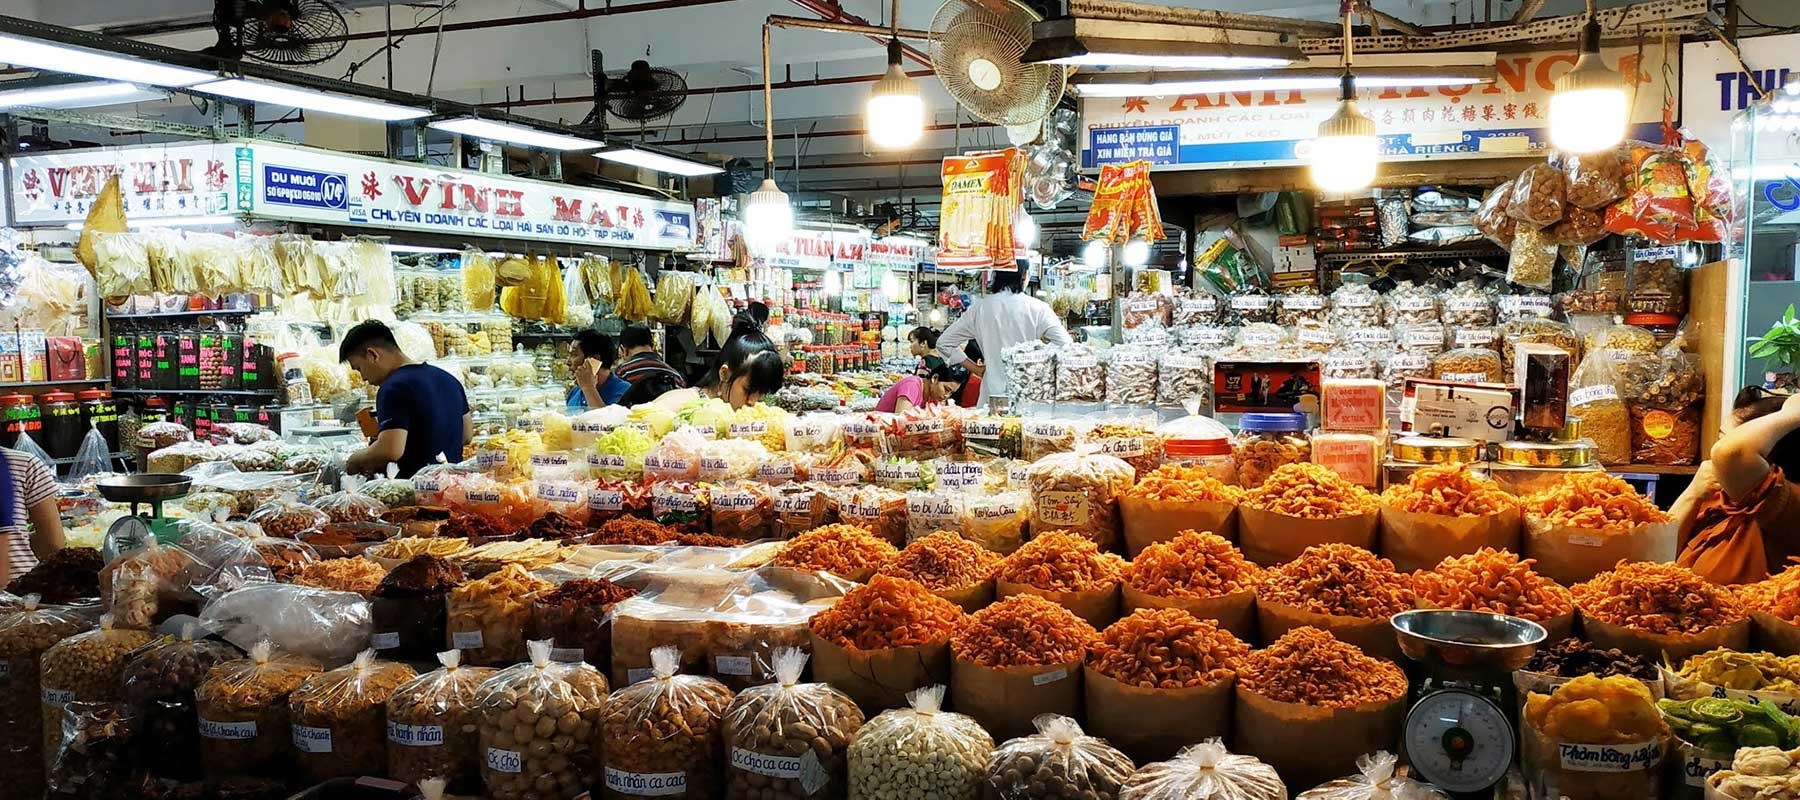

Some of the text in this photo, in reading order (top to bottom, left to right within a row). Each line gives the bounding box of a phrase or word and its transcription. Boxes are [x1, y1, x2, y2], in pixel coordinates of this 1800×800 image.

[1096, 132, 1118, 144] HÀNG
[1136, 129, 1159, 142] ĐÚNG
[1160, 129, 1173, 141] GIÁ
[1097, 149, 1112, 159] XIN
[1138, 145, 1156, 158] TRẢ
[1157, 144, 1172, 156] GIÁ
[951, 178, 985, 191] DAMEX
[351, 208, 367, 217] VISA
[552, 194, 630, 230] MAI
[425, 213, 464, 227] DOANH
[468, 215, 489, 228] CÁC
[417, 726, 442, 742] nhân
[488, 750, 520, 768] Óc chó
[744, 754, 762, 768] chó
[763, 758, 776, 771] ca
[778, 760, 801, 771] cao
[624, 773, 646, 789] nhân
[649, 777, 665, 789] ca
[666, 774, 688, 787] cao
